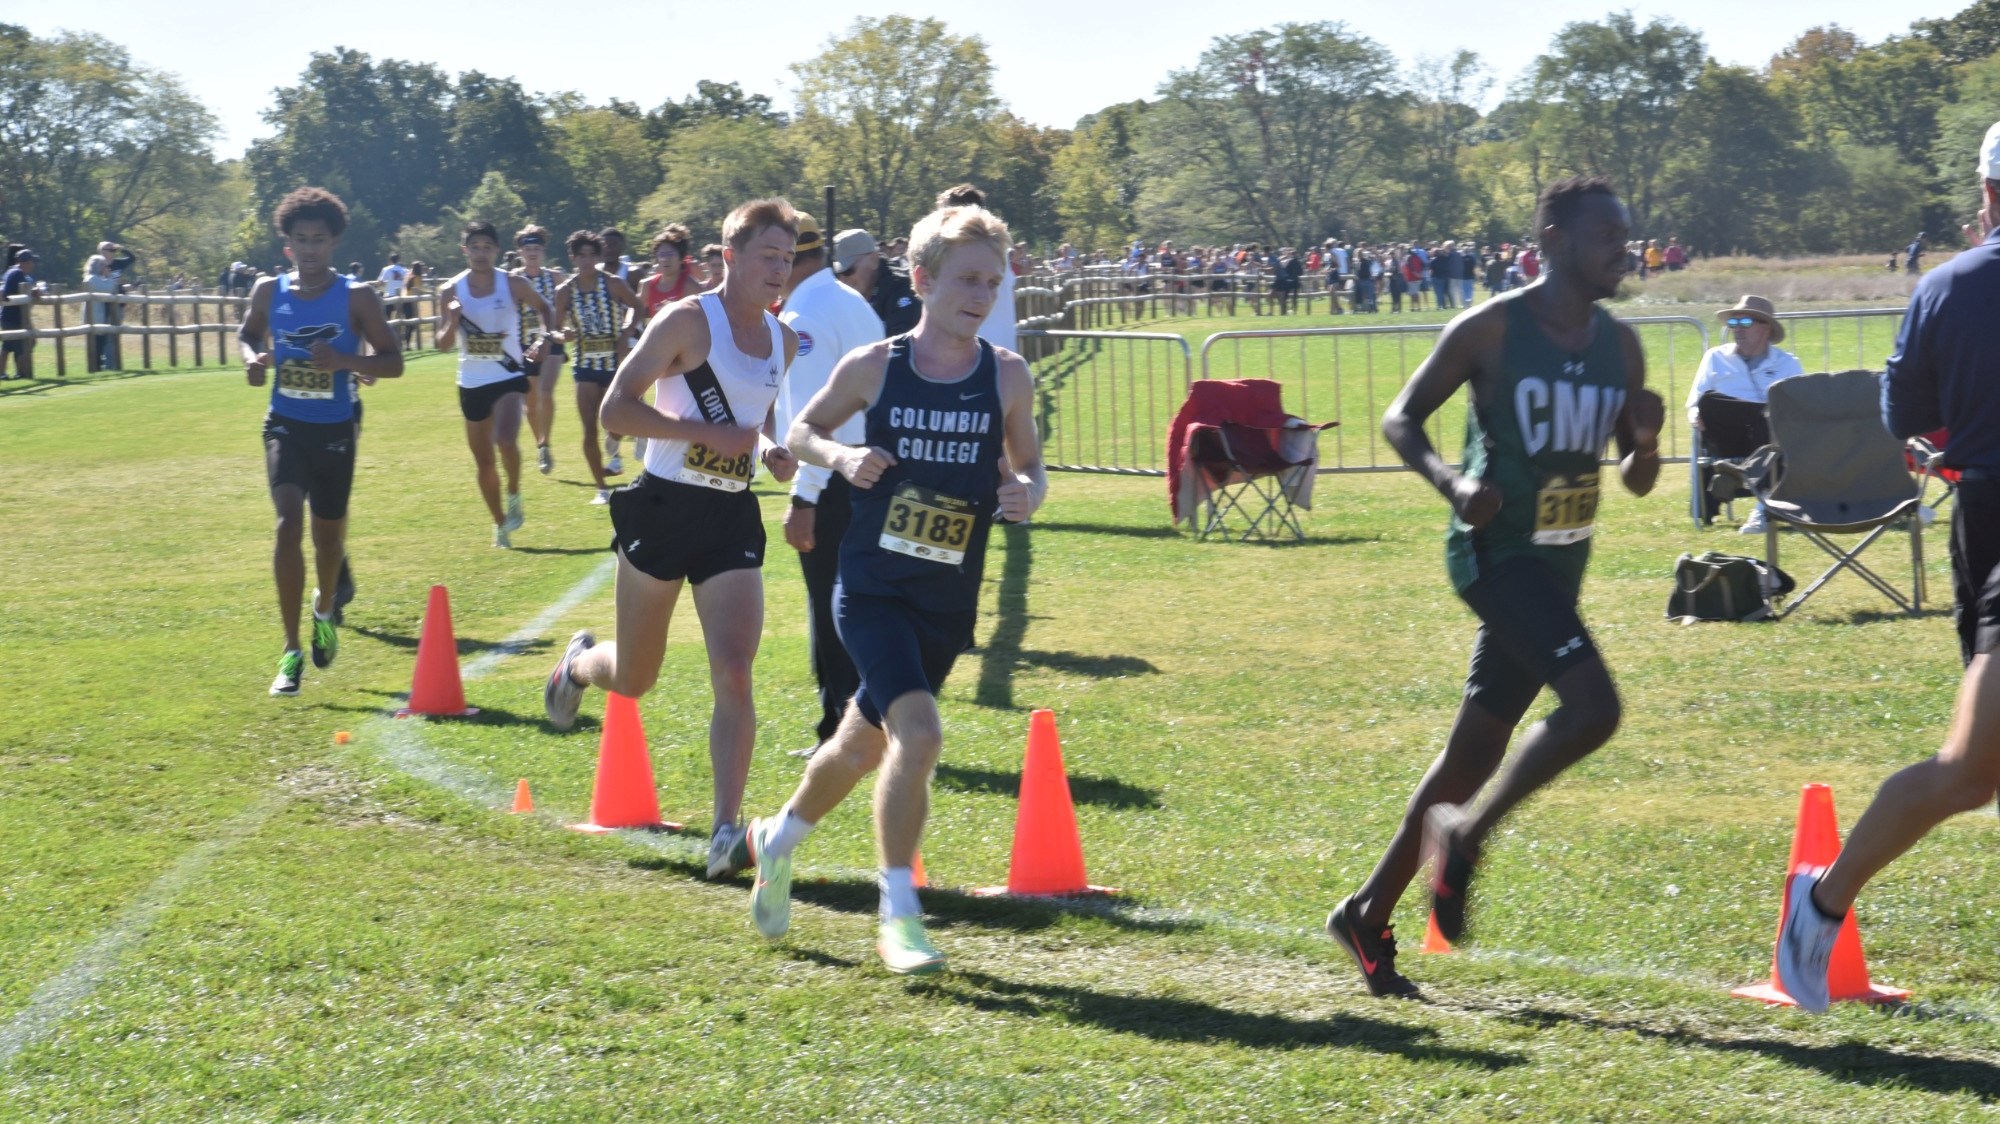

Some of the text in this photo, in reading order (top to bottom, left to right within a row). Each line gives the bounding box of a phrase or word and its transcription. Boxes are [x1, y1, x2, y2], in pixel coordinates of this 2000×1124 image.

[280, 368, 330, 389] 3338
[700, 386, 729, 424] FORT
[889, 406, 991, 434] COLUMBIA
[897, 436, 980, 464] COLLEGE
[889, 503, 968, 546] 3183
